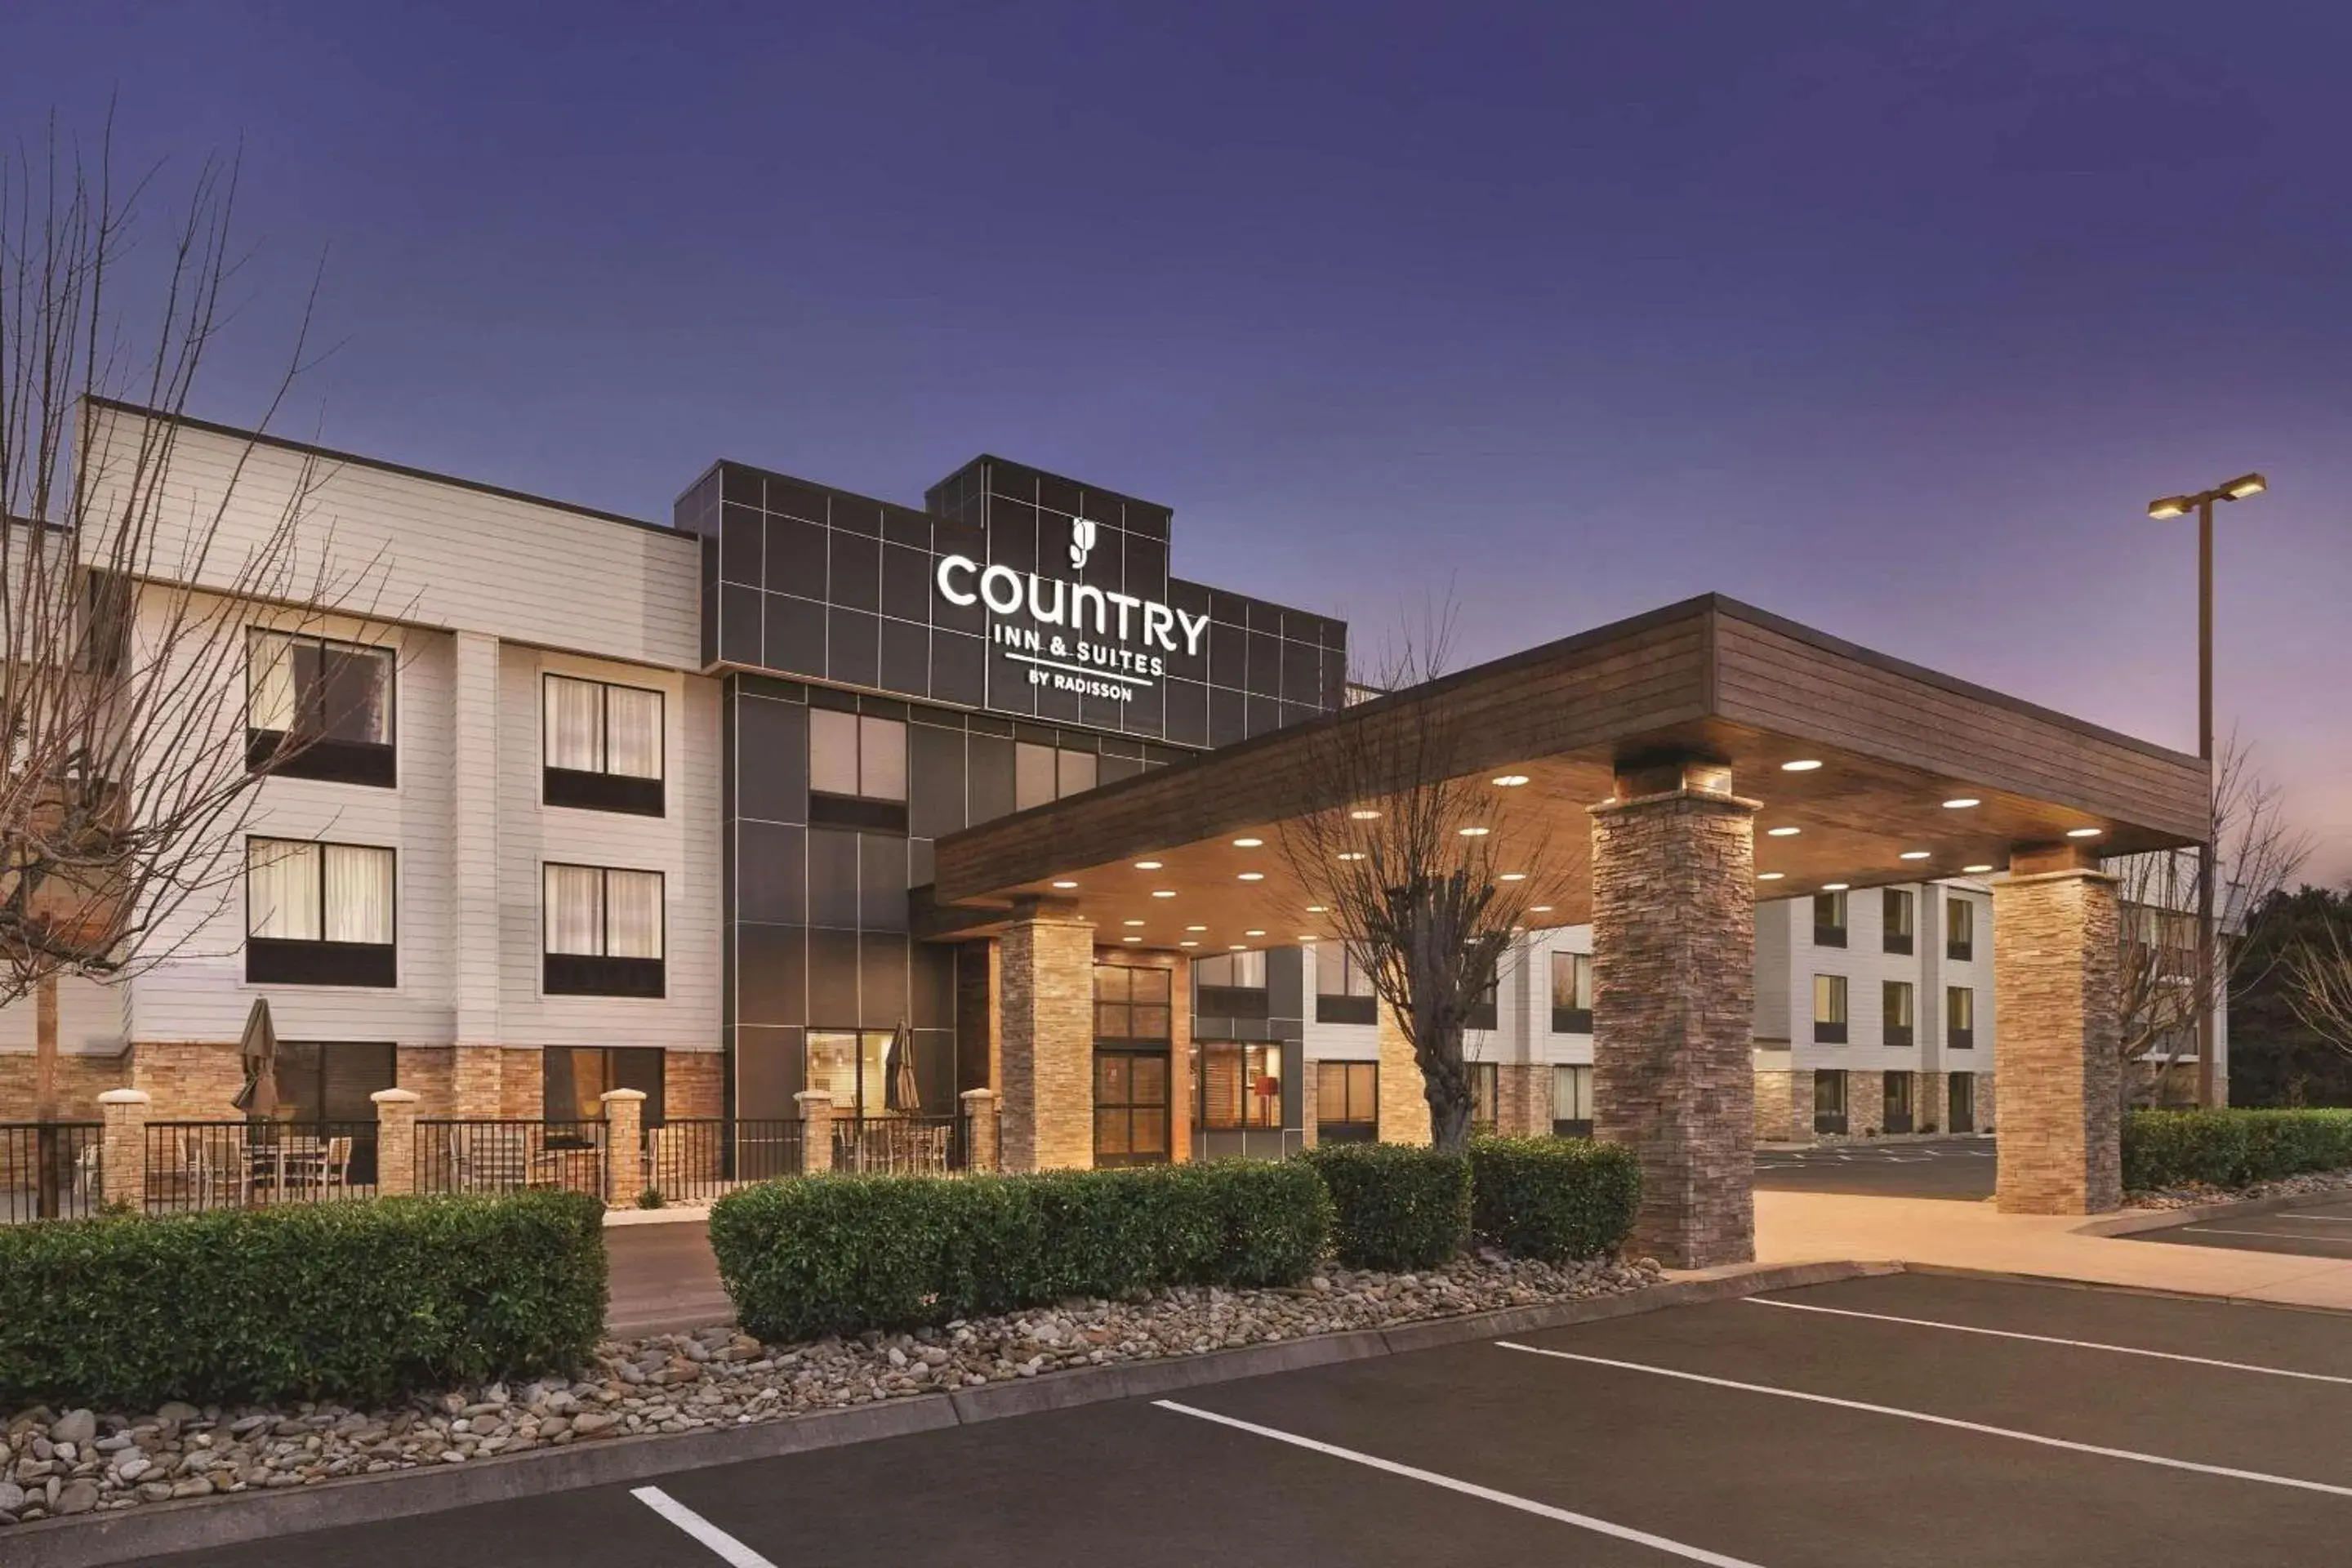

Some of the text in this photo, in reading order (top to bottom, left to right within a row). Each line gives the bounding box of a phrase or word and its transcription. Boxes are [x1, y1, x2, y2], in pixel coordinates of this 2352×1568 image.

[994, 624, 1164, 676] INN & SUITES
[1029, 670, 1133, 702] BY RADISSON
